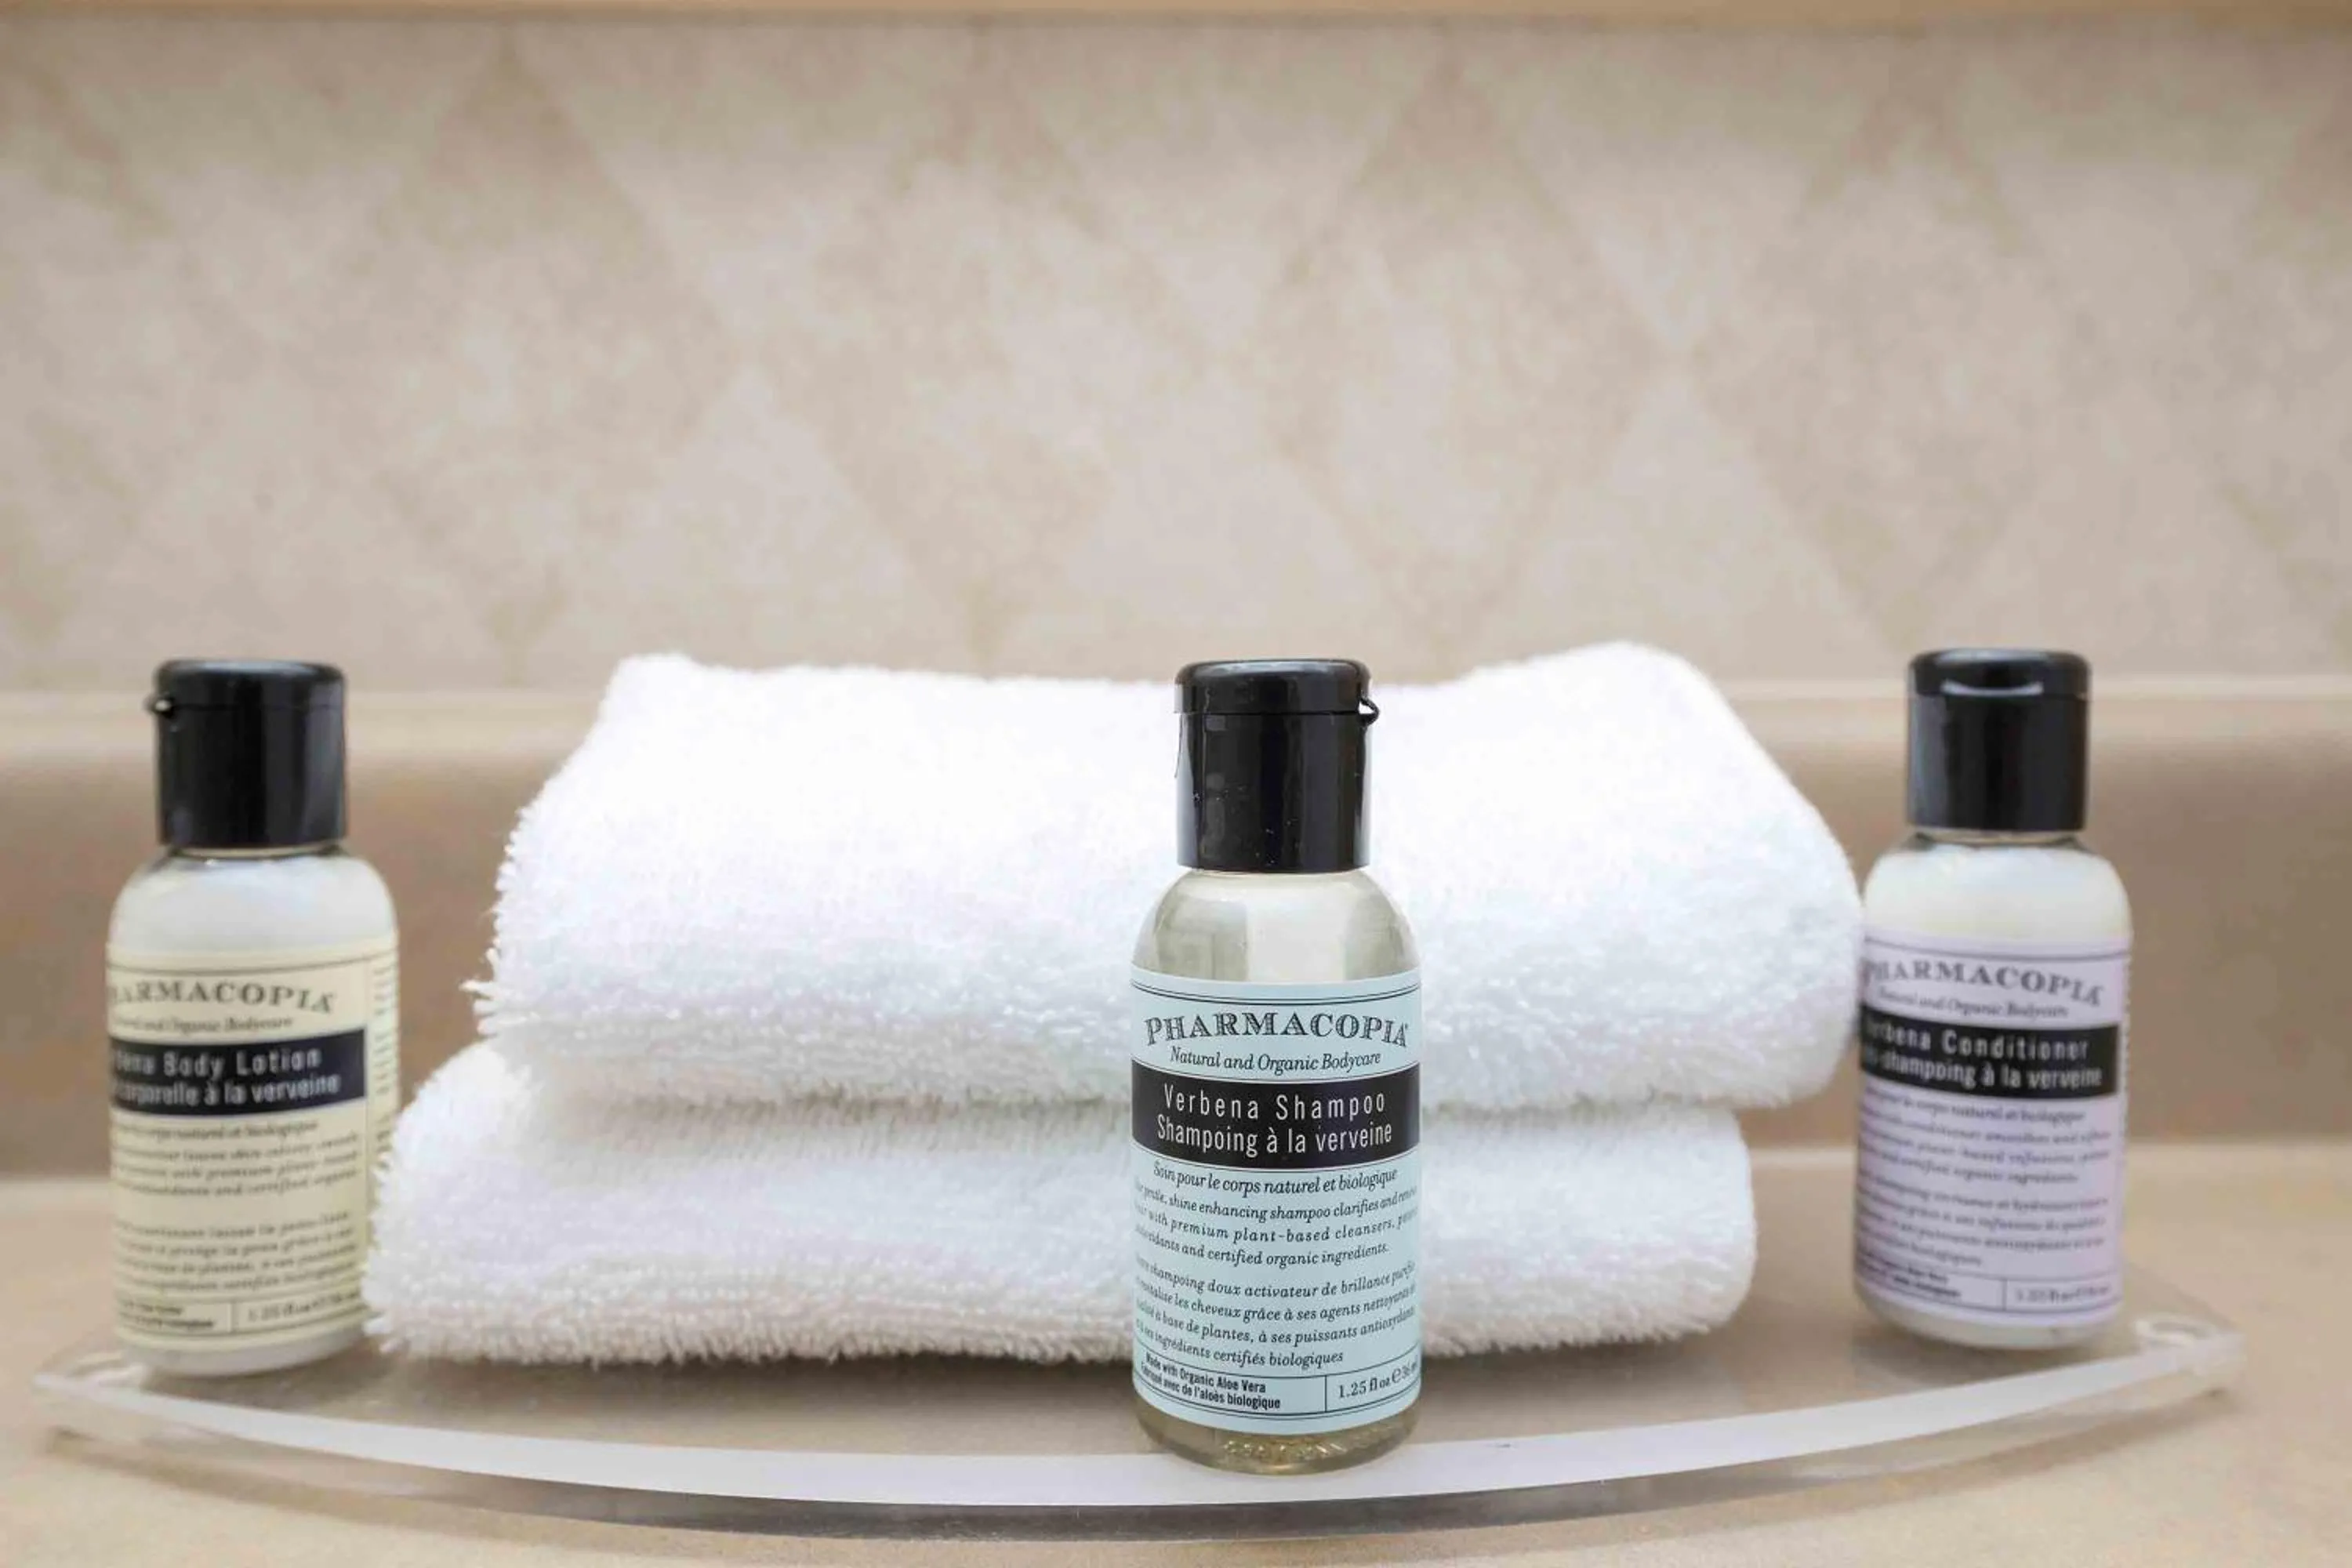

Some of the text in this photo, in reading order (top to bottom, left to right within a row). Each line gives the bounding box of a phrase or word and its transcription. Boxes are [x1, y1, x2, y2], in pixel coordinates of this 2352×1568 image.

[1143, 1011, 1406, 1047] PHARMACOPIA
[1941, 1029, 2089, 1061] Conditioner
[163, 1051, 226, 1081] Body
[237, 1047, 322, 1076] Lotion
[1171, 1045, 1381, 1076] Natural and Organic Bodycare
[224, 1080, 247, 1104] la
[251, 1074, 341, 1103] verveine
[1980, 1062, 1994, 1088] à
[2001, 1064, 2021, 1088] la
[2027, 1068, 2103, 1091] verveine
[1163, 1082, 1385, 1121] Verbena Shampoo
[1157, 1114, 1392, 1158] Shampoing à la verveine
[1153, 1160, 1398, 1198] Soin pour le corps naturel et biologique
[1169, 1193, 1197, 1211] shine
[1199, 1200, 1268, 1224] enhancing
[1269, 1205, 1330, 1224] shampoo
[1334, 1198, 1378, 1218] clarifies
[1171, 1219, 1229, 1240] premium
[1233, 1226, 1330, 1245] plant-based
[1181, 1244, 1205, 1258] and
[1207, 1248, 1263, 1267] certified
[1266, 1250, 1319, 1269] organic
[1207, 1279, 1242, 1296] doux
[1244, 1286, 1319, 1298] activateur
[1321, 1282, 1338, 1297] de
[1175, 1294, 1189, 1308] les
[1191, 1298, 1241, 1318] cheveux
[1243, 1308, 1281, 1323] grâce
[1283, 1308, 1293, 1321] à
[1297, 1309, 1317, 1321] ses
[1319, 1304, 1360, 1323] agents
[1186, 1319, 1200, 1334] de
[1201, 1323, 1254, 1344] plantes,
[1258, 1330, 1268, 1343] à
[1271, 1332, 1292, 1344] ses
[1294, 1327, 1357, 1348] puissants
[1214, 1349, 1265, 1368] certifiés
[1269, 1351, 1344, 1370] biologiques
[1180, 1367, 1214, 1386] Organic
[1216, 1376, 1239, 1392] Aloe
[1242, 1378, 1267, 1393] Vera
[1339, 1379, 1367, 1399] 1.25
[1181, 1382, 1192, 1396] de
[1227, 1391, 1281, 1410] biologique
